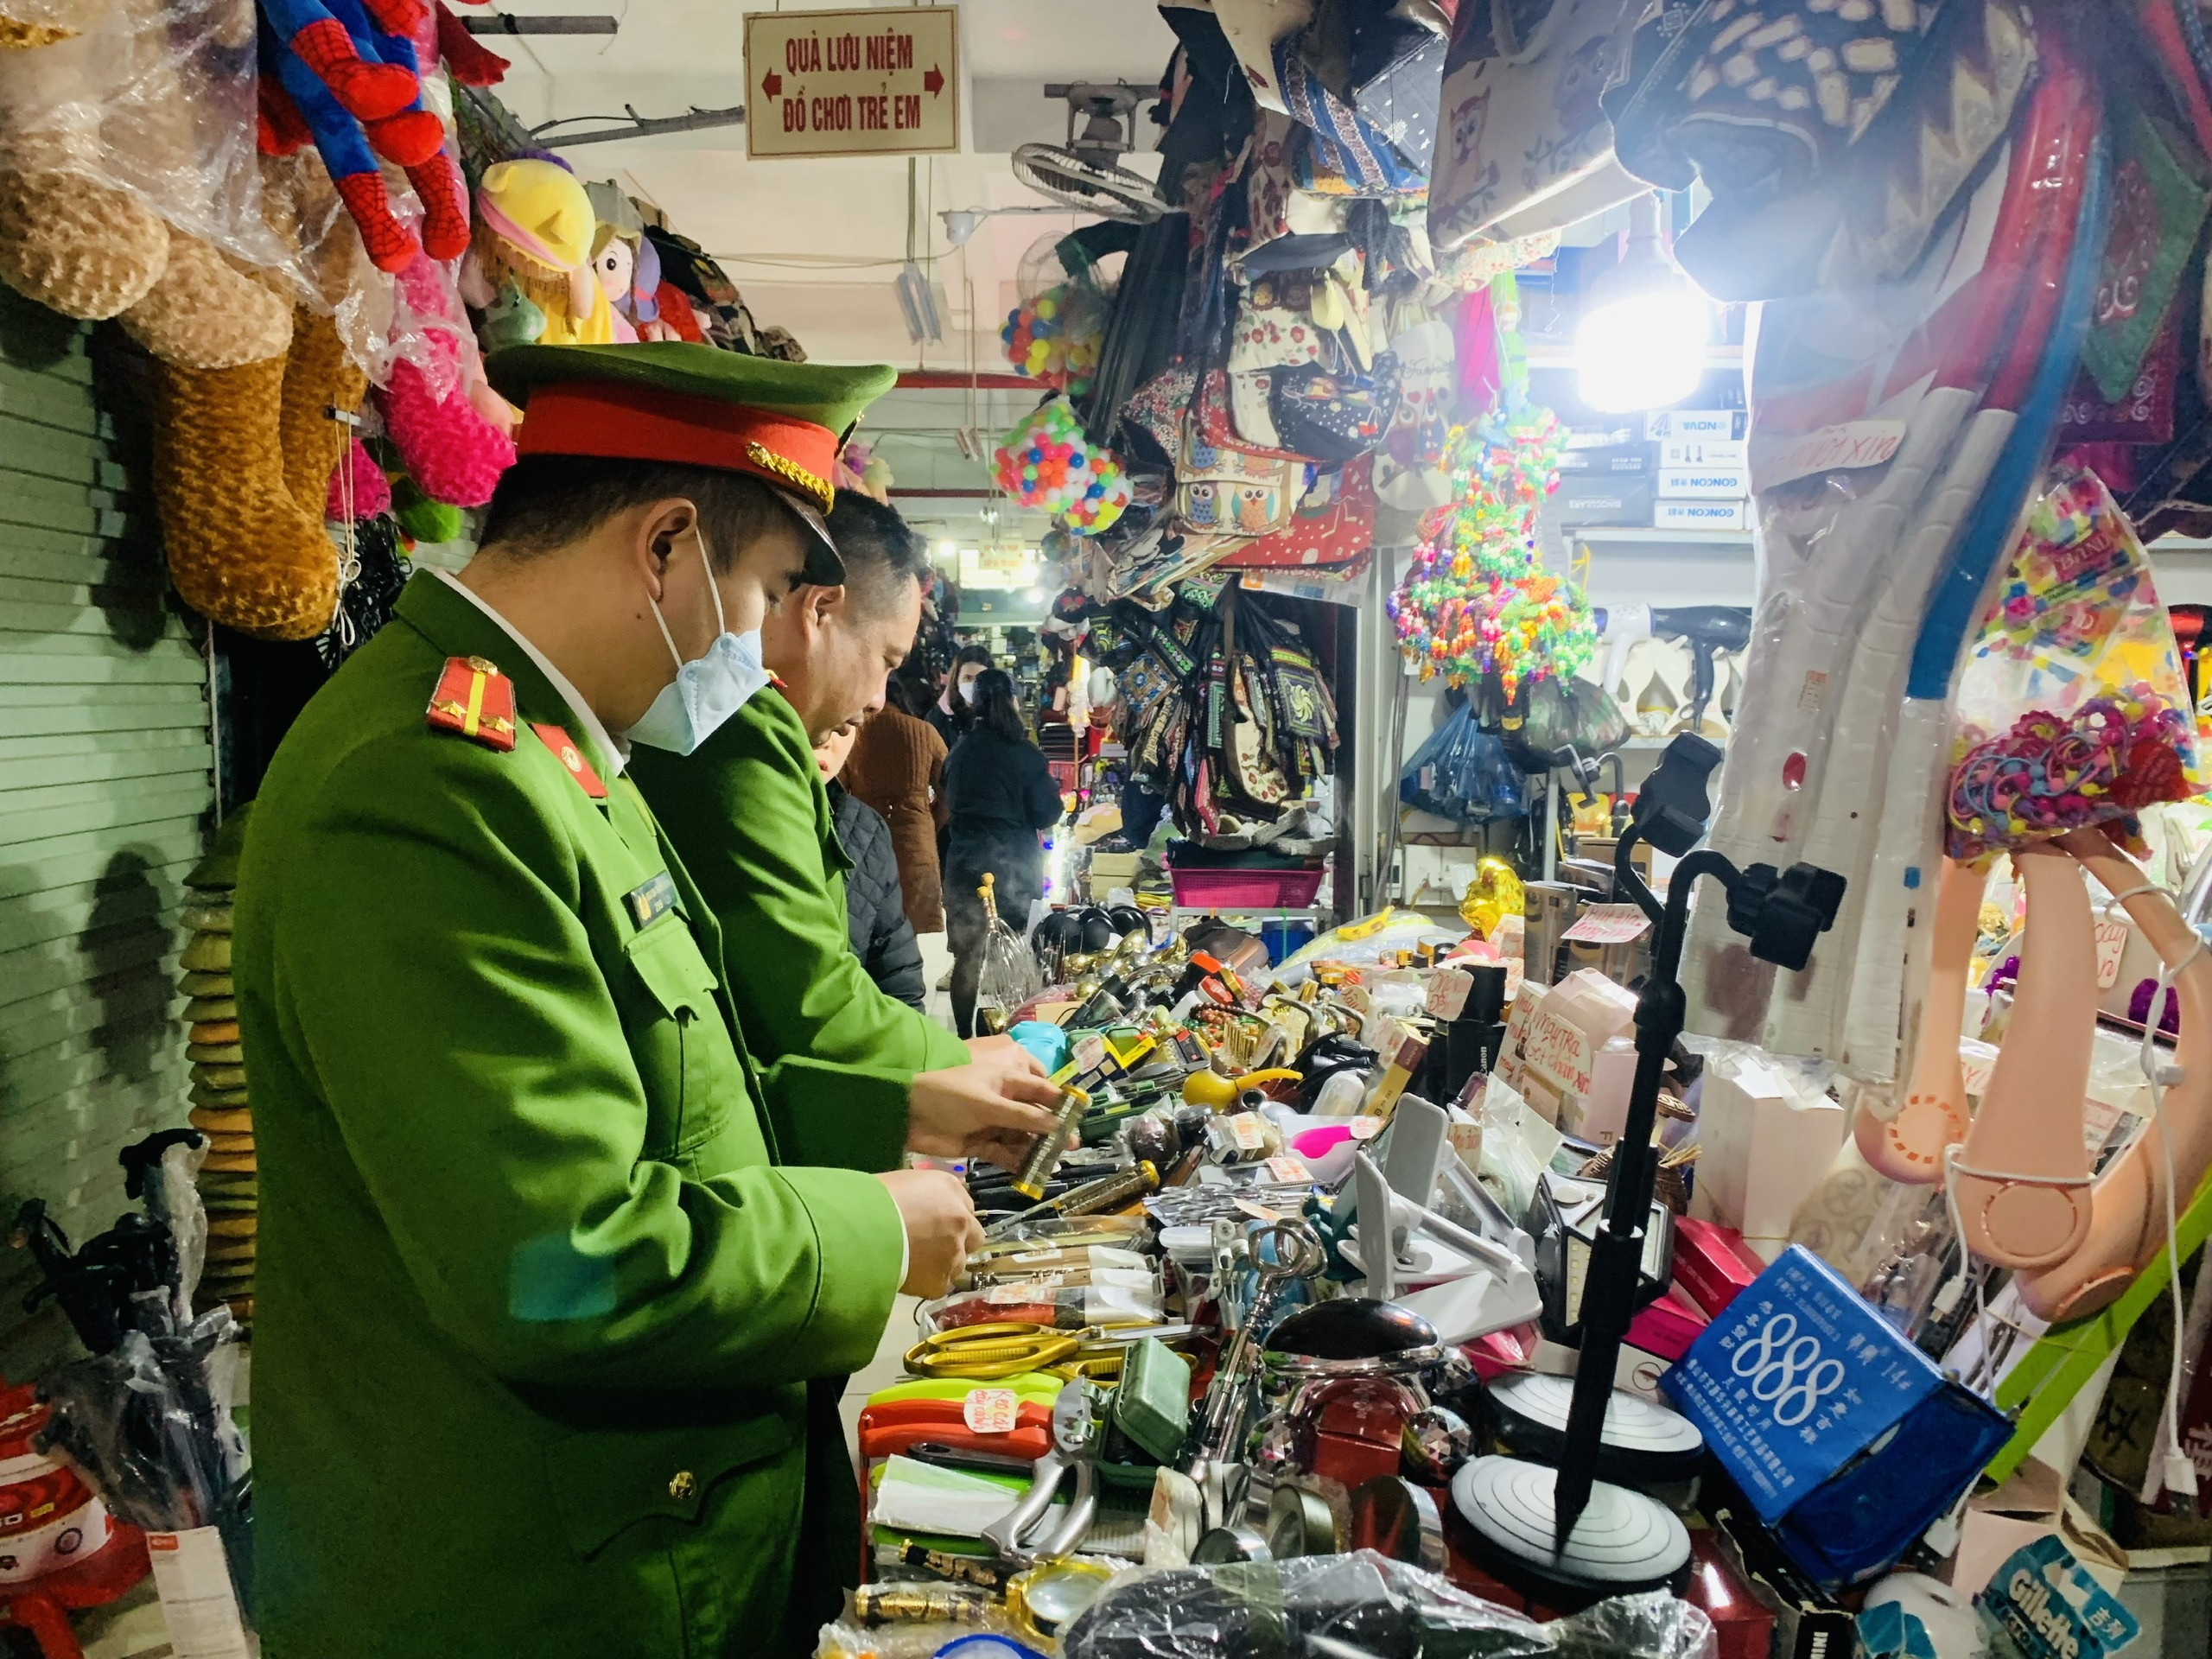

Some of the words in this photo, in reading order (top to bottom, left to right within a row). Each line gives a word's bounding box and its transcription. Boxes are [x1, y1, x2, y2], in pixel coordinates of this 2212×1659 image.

[785, 29, 821, 76] QUÀ
[827, 33, 861, 72] LƯU
[867, 27, 912, 76] NIỆM
[812, 93, 852, 131] CHƠI
[857, 81, 888, 130] TRẺ
[894, 94, 921, 130] EM
[1732, 1313, 1845, 1427] 888
[2009, 1569, 2079, 1659] Gillette
